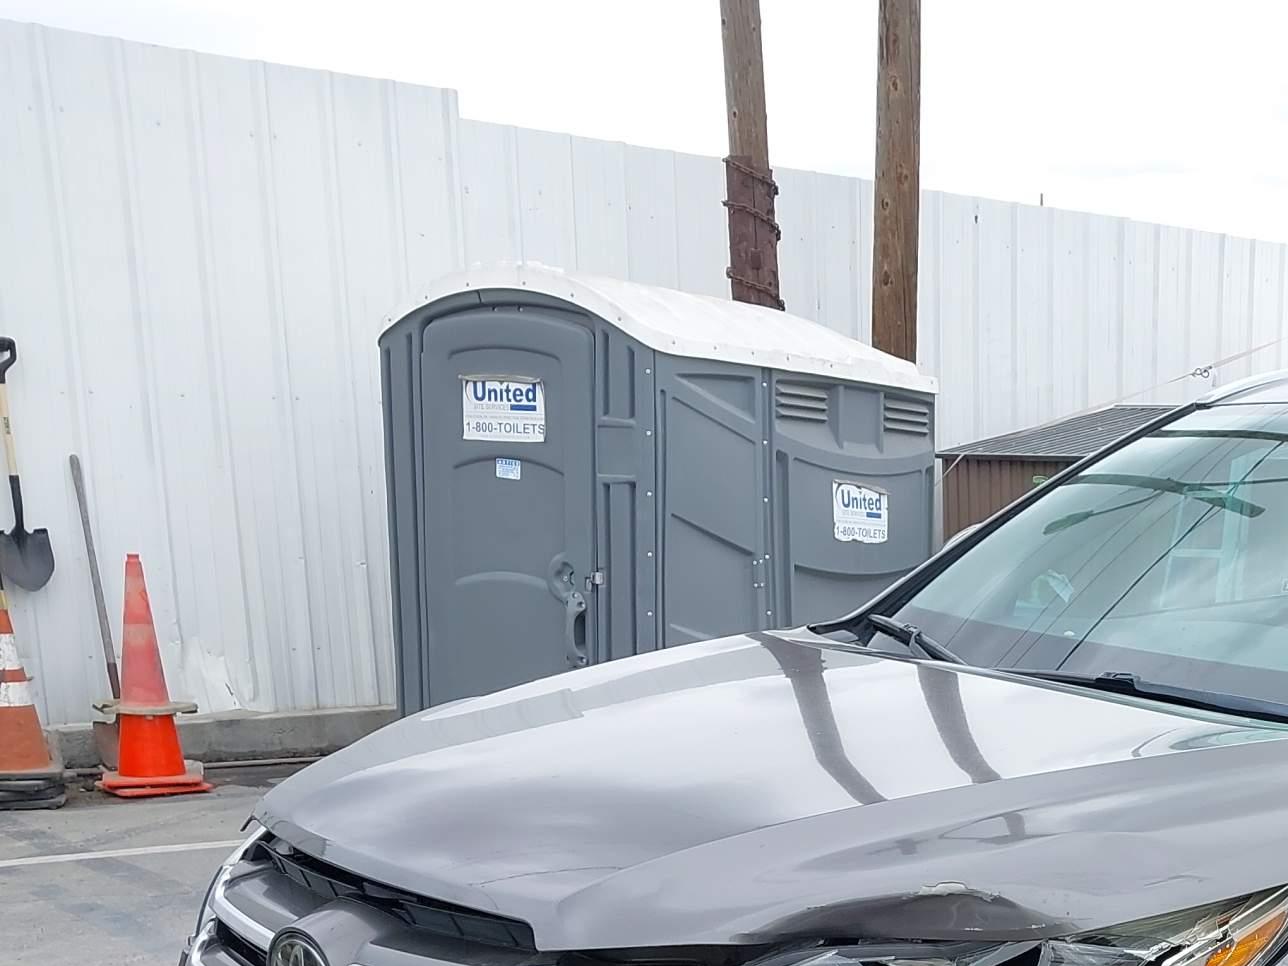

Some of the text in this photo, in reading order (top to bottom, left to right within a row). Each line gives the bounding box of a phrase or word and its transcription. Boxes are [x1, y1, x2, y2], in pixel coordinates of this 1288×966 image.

[472, 380, 537, 403] United
[465, 422, 545, 435] 1-800-TOILETS
[841, 489, 882, 511] United
[836, 526, 886, 540] 1-800-TOILETS
